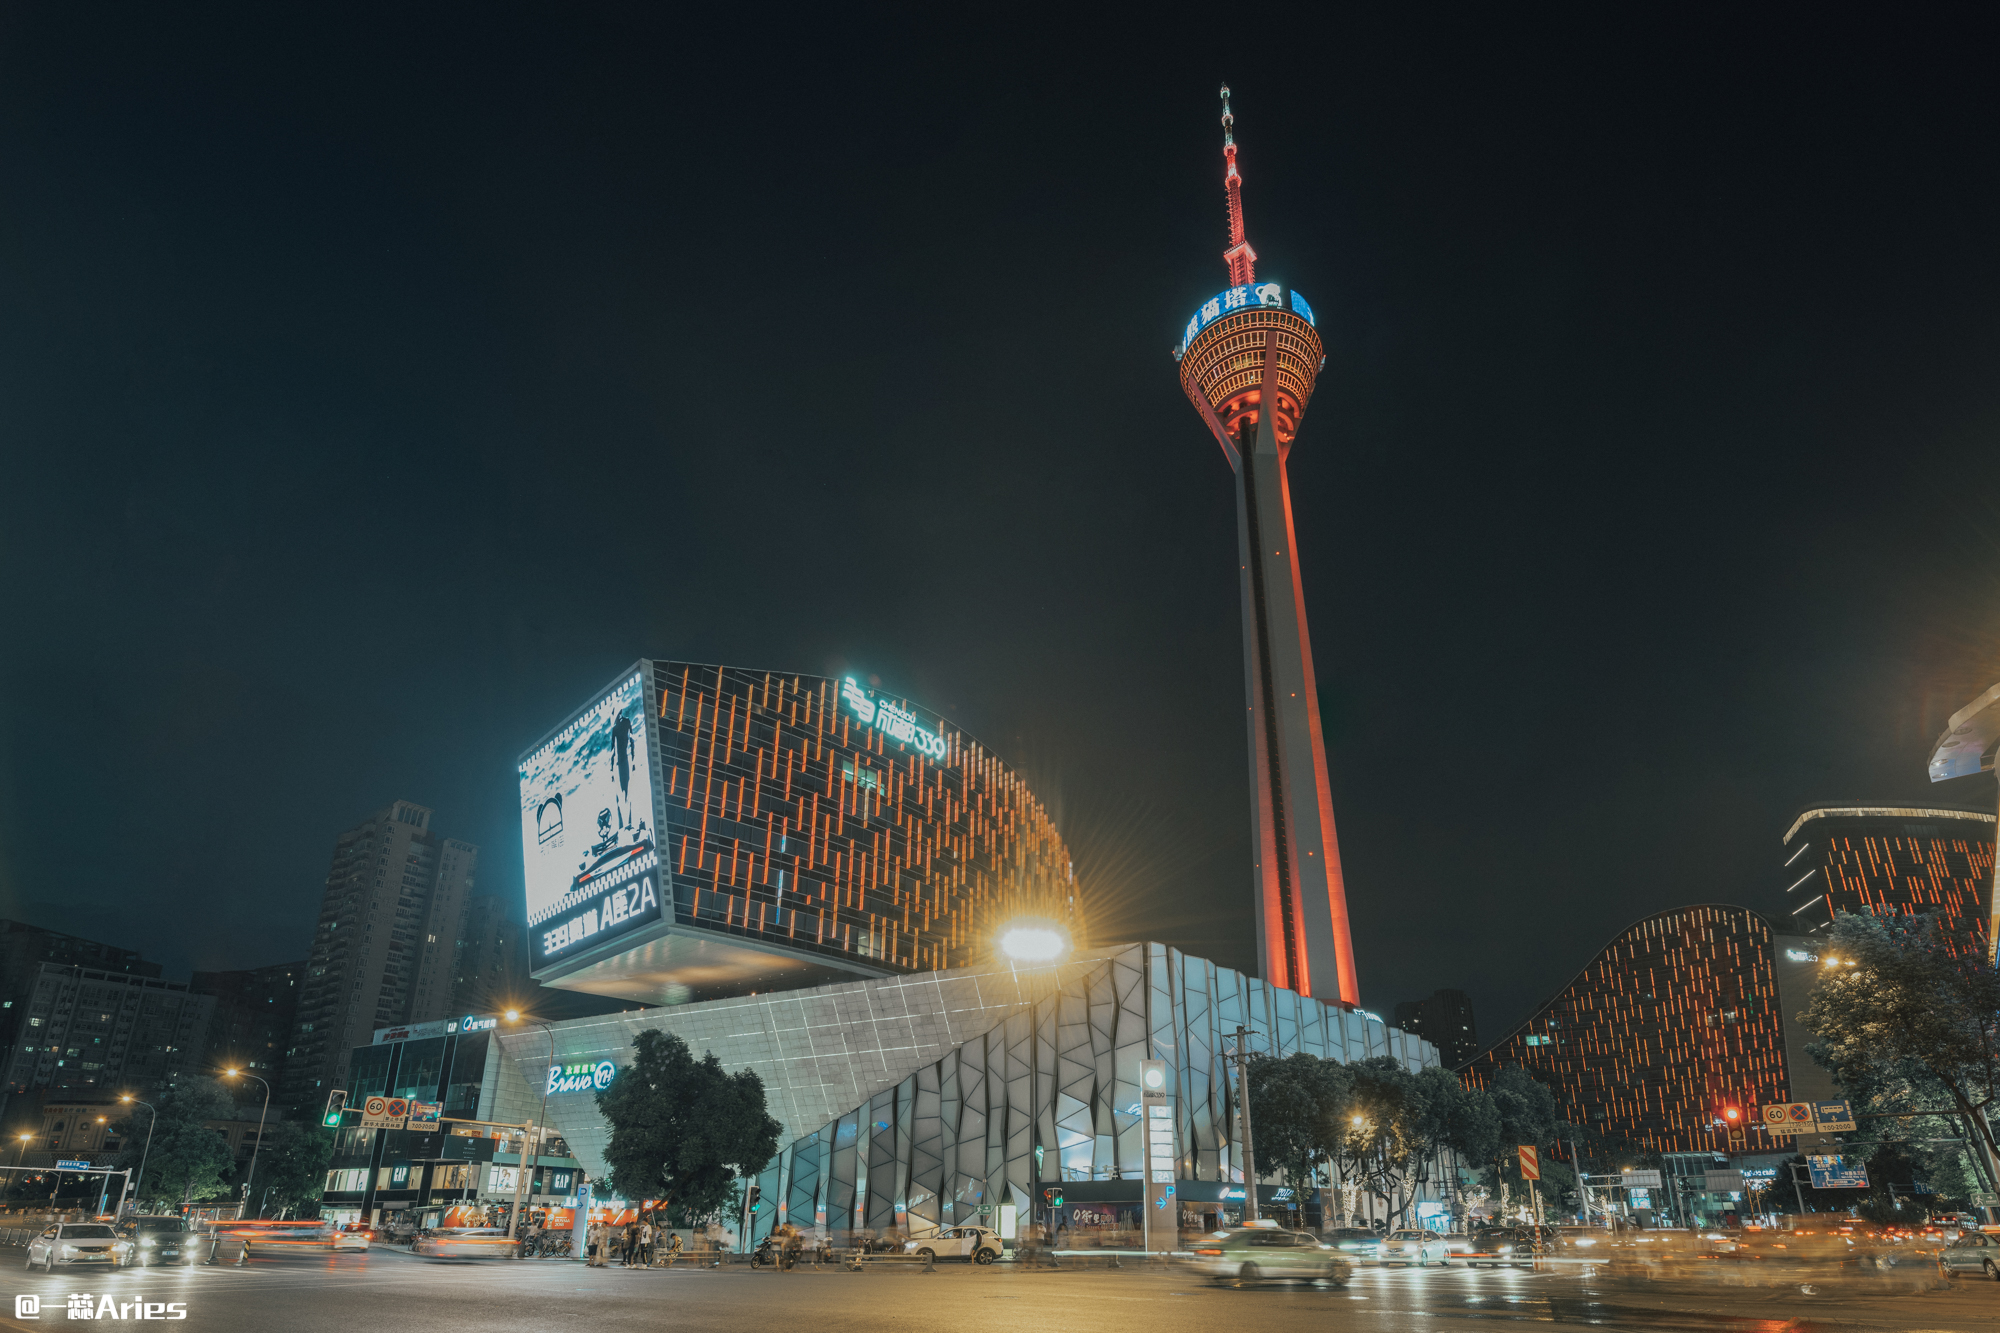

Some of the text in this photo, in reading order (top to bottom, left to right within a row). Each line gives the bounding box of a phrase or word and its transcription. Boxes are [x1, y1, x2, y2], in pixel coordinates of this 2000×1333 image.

[879, 700, 916, 724] CHENGDU
[600, 877, 657, 931] A座2A
[447, 1022, 458, 1033] GAP
[546, 1065, 593, 1096] Bravo
[369, 1102, 383, 1111] 60
[1769, 1110, 1783, 1119] 60
[1822, 1123, 1851, 1131] 7:00-20:00
[392, 1168, 406, 1182] GAP
[554, 1174, 570, 1189] GAP
[1157, 1172, 1170, 1180] 2A
[1165, 1185, 1176, 1199] P
